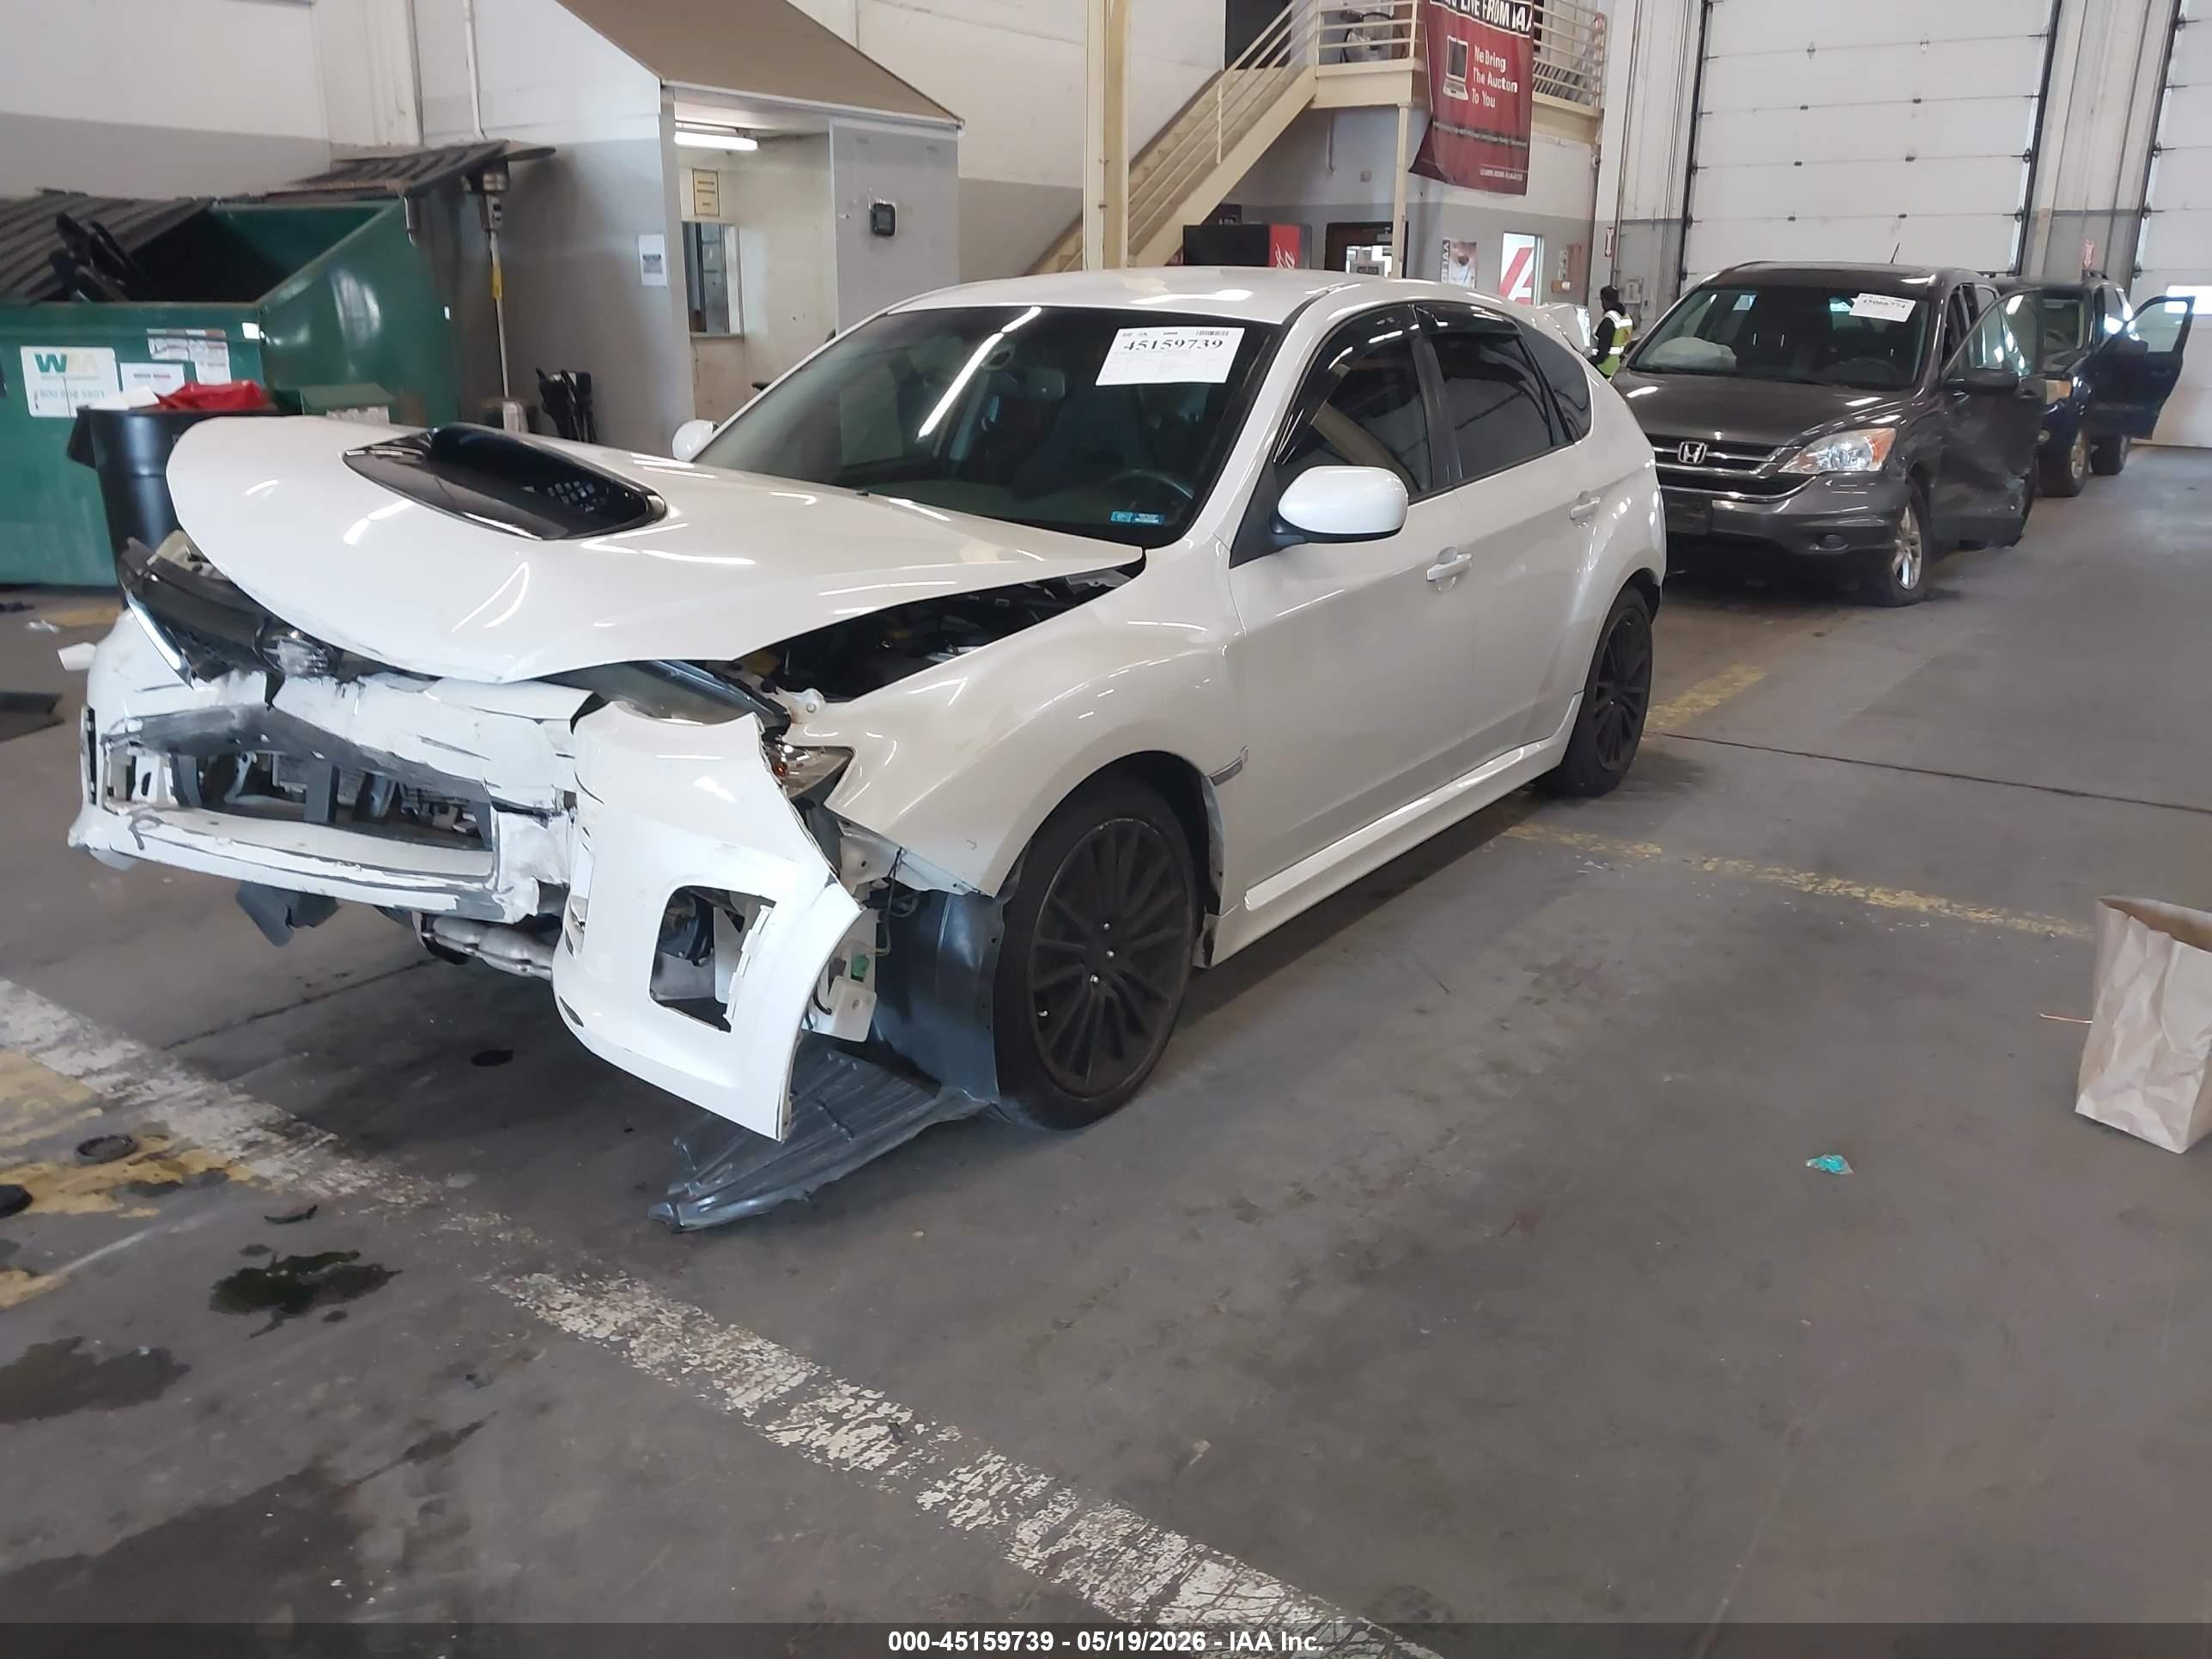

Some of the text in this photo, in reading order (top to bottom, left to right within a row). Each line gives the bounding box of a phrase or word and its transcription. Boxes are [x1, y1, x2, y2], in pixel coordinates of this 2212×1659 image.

[1483, 0, 1510, 27] FROM
[1486, 49, 1506, 73] Bring
[1474, 66, 1486, 84] The
[1472, 88, 1496, 108] To You
[1123, 339, 1224, 350] 45159739
